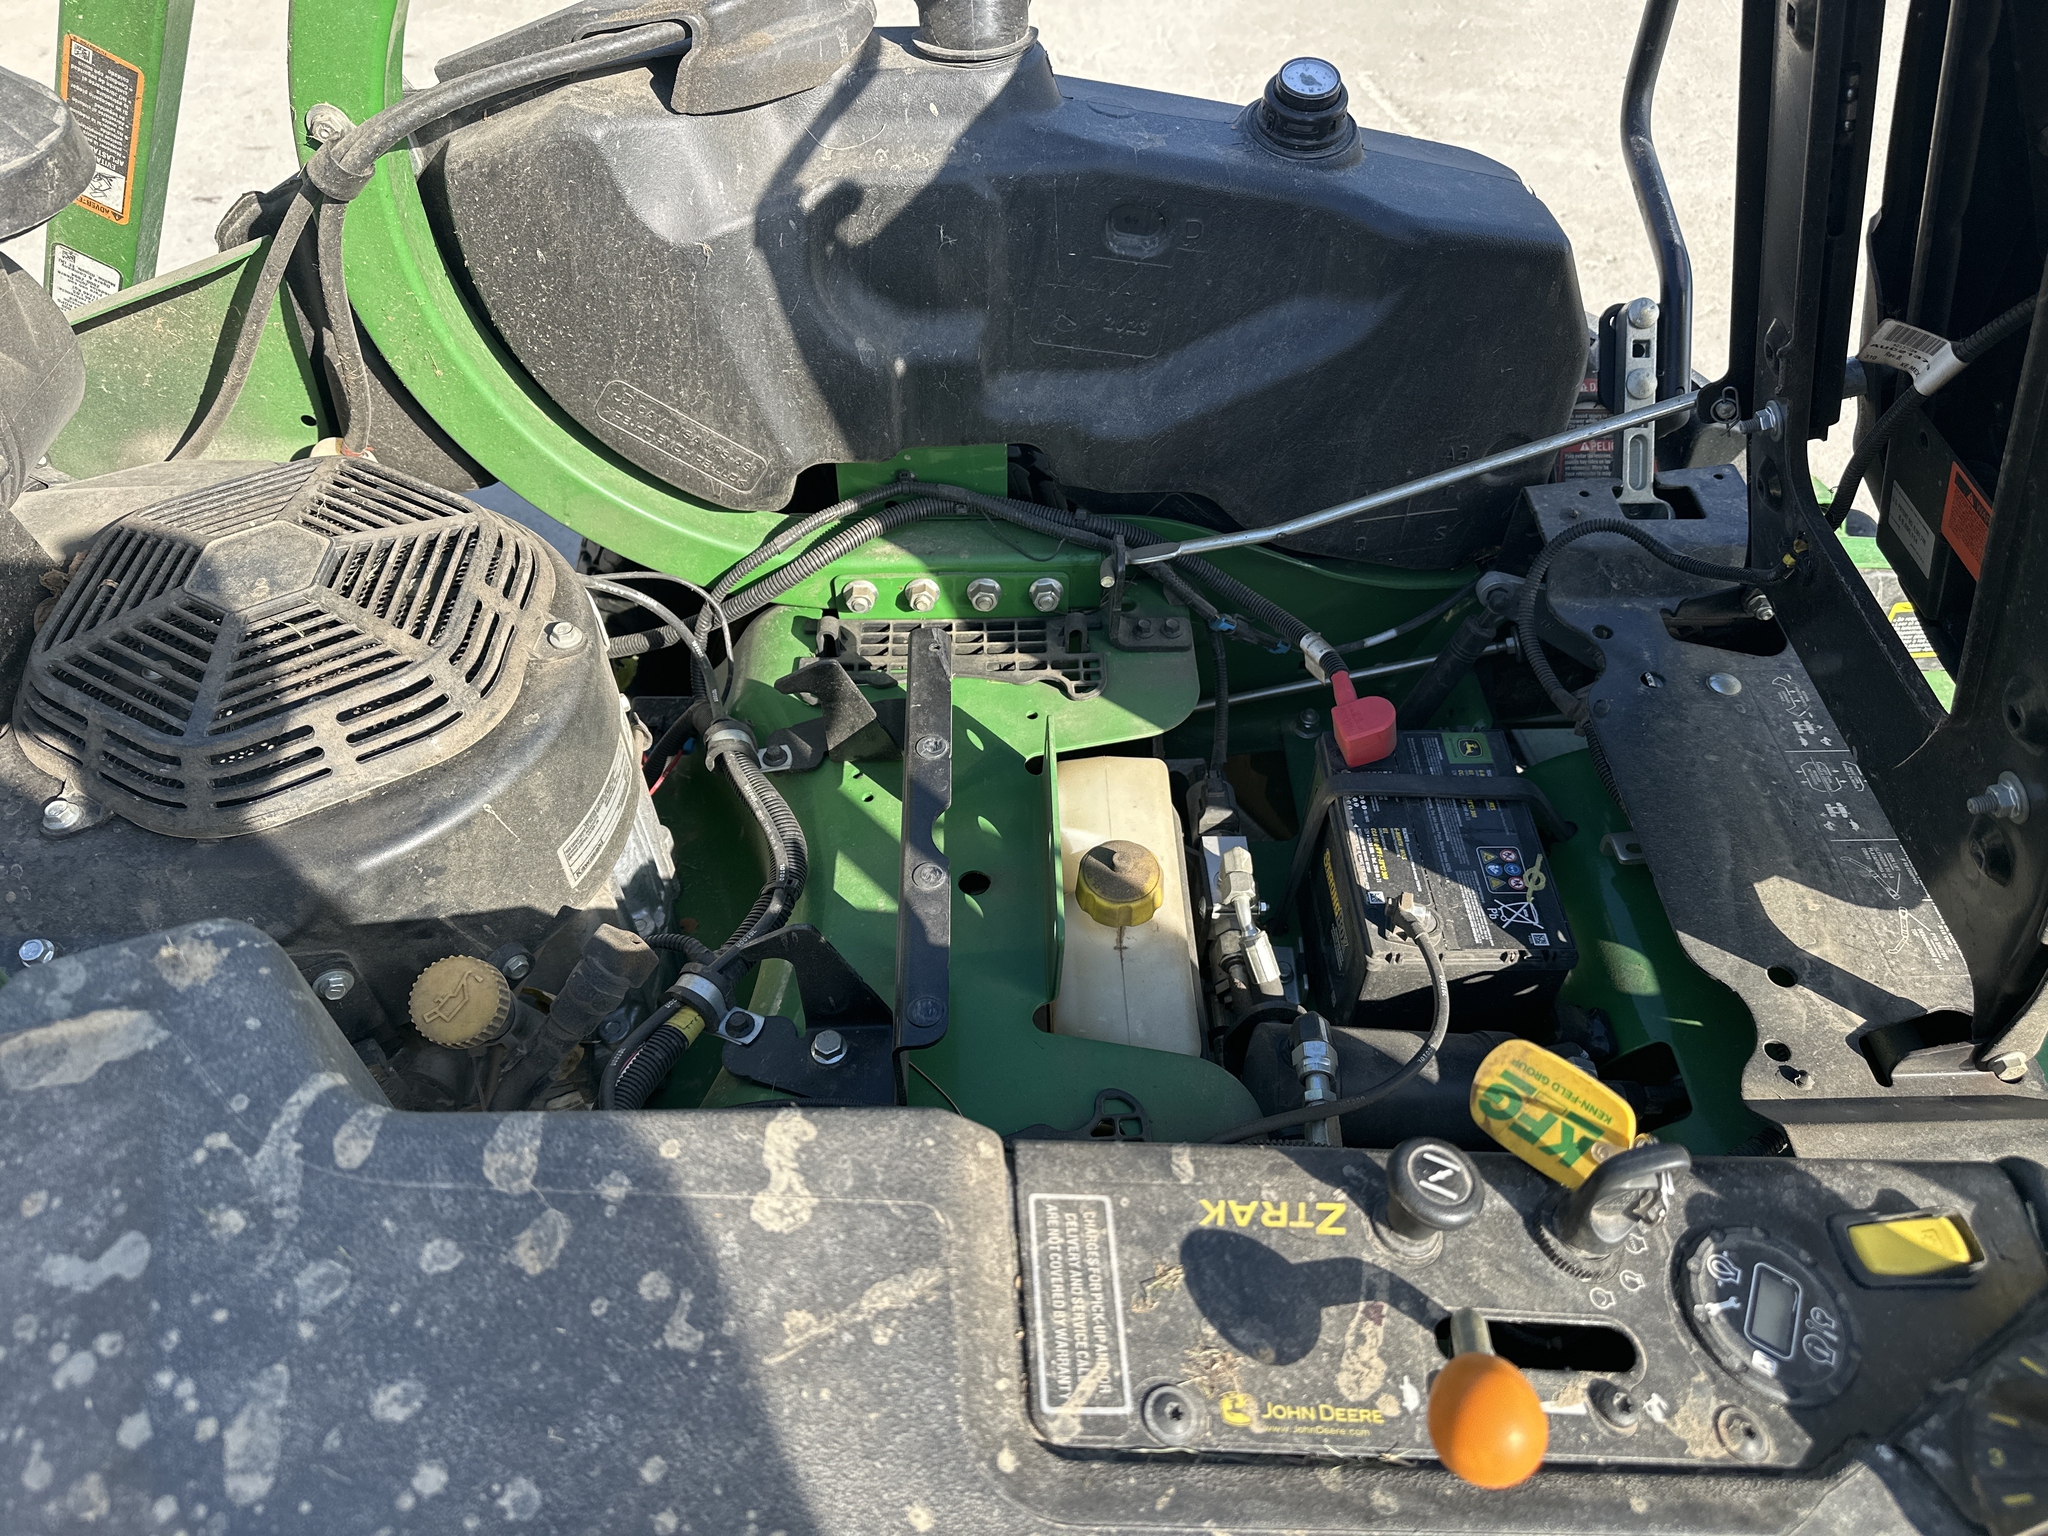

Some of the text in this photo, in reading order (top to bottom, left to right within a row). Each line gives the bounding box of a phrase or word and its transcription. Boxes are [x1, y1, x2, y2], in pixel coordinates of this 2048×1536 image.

[93, 153, 116, 171] EVITA
[75, 193, 109, 216] ADVERTE
[1486, 907, 1500, 920] Pb
[1510, 1058, 1613, 1125] KENN-FELD GROUP
[1478, 1083, 1595, 1169] KFG
[1198, 1199, 1347, 1236] ZTRAK
[1082, 1210, 1100, 1265] CHARGES
[1068, 1268, 1083, 1295] AND
[1087, 1266, 1102, 1292] FOR
[1044, 1203, 1073, 1400] ARE NOT COVERED BY WARRANTY
[1070, 1295, 1088, 1349] SERVICE
[1262, 1401, 1385, 1424] JOHN DEERE
